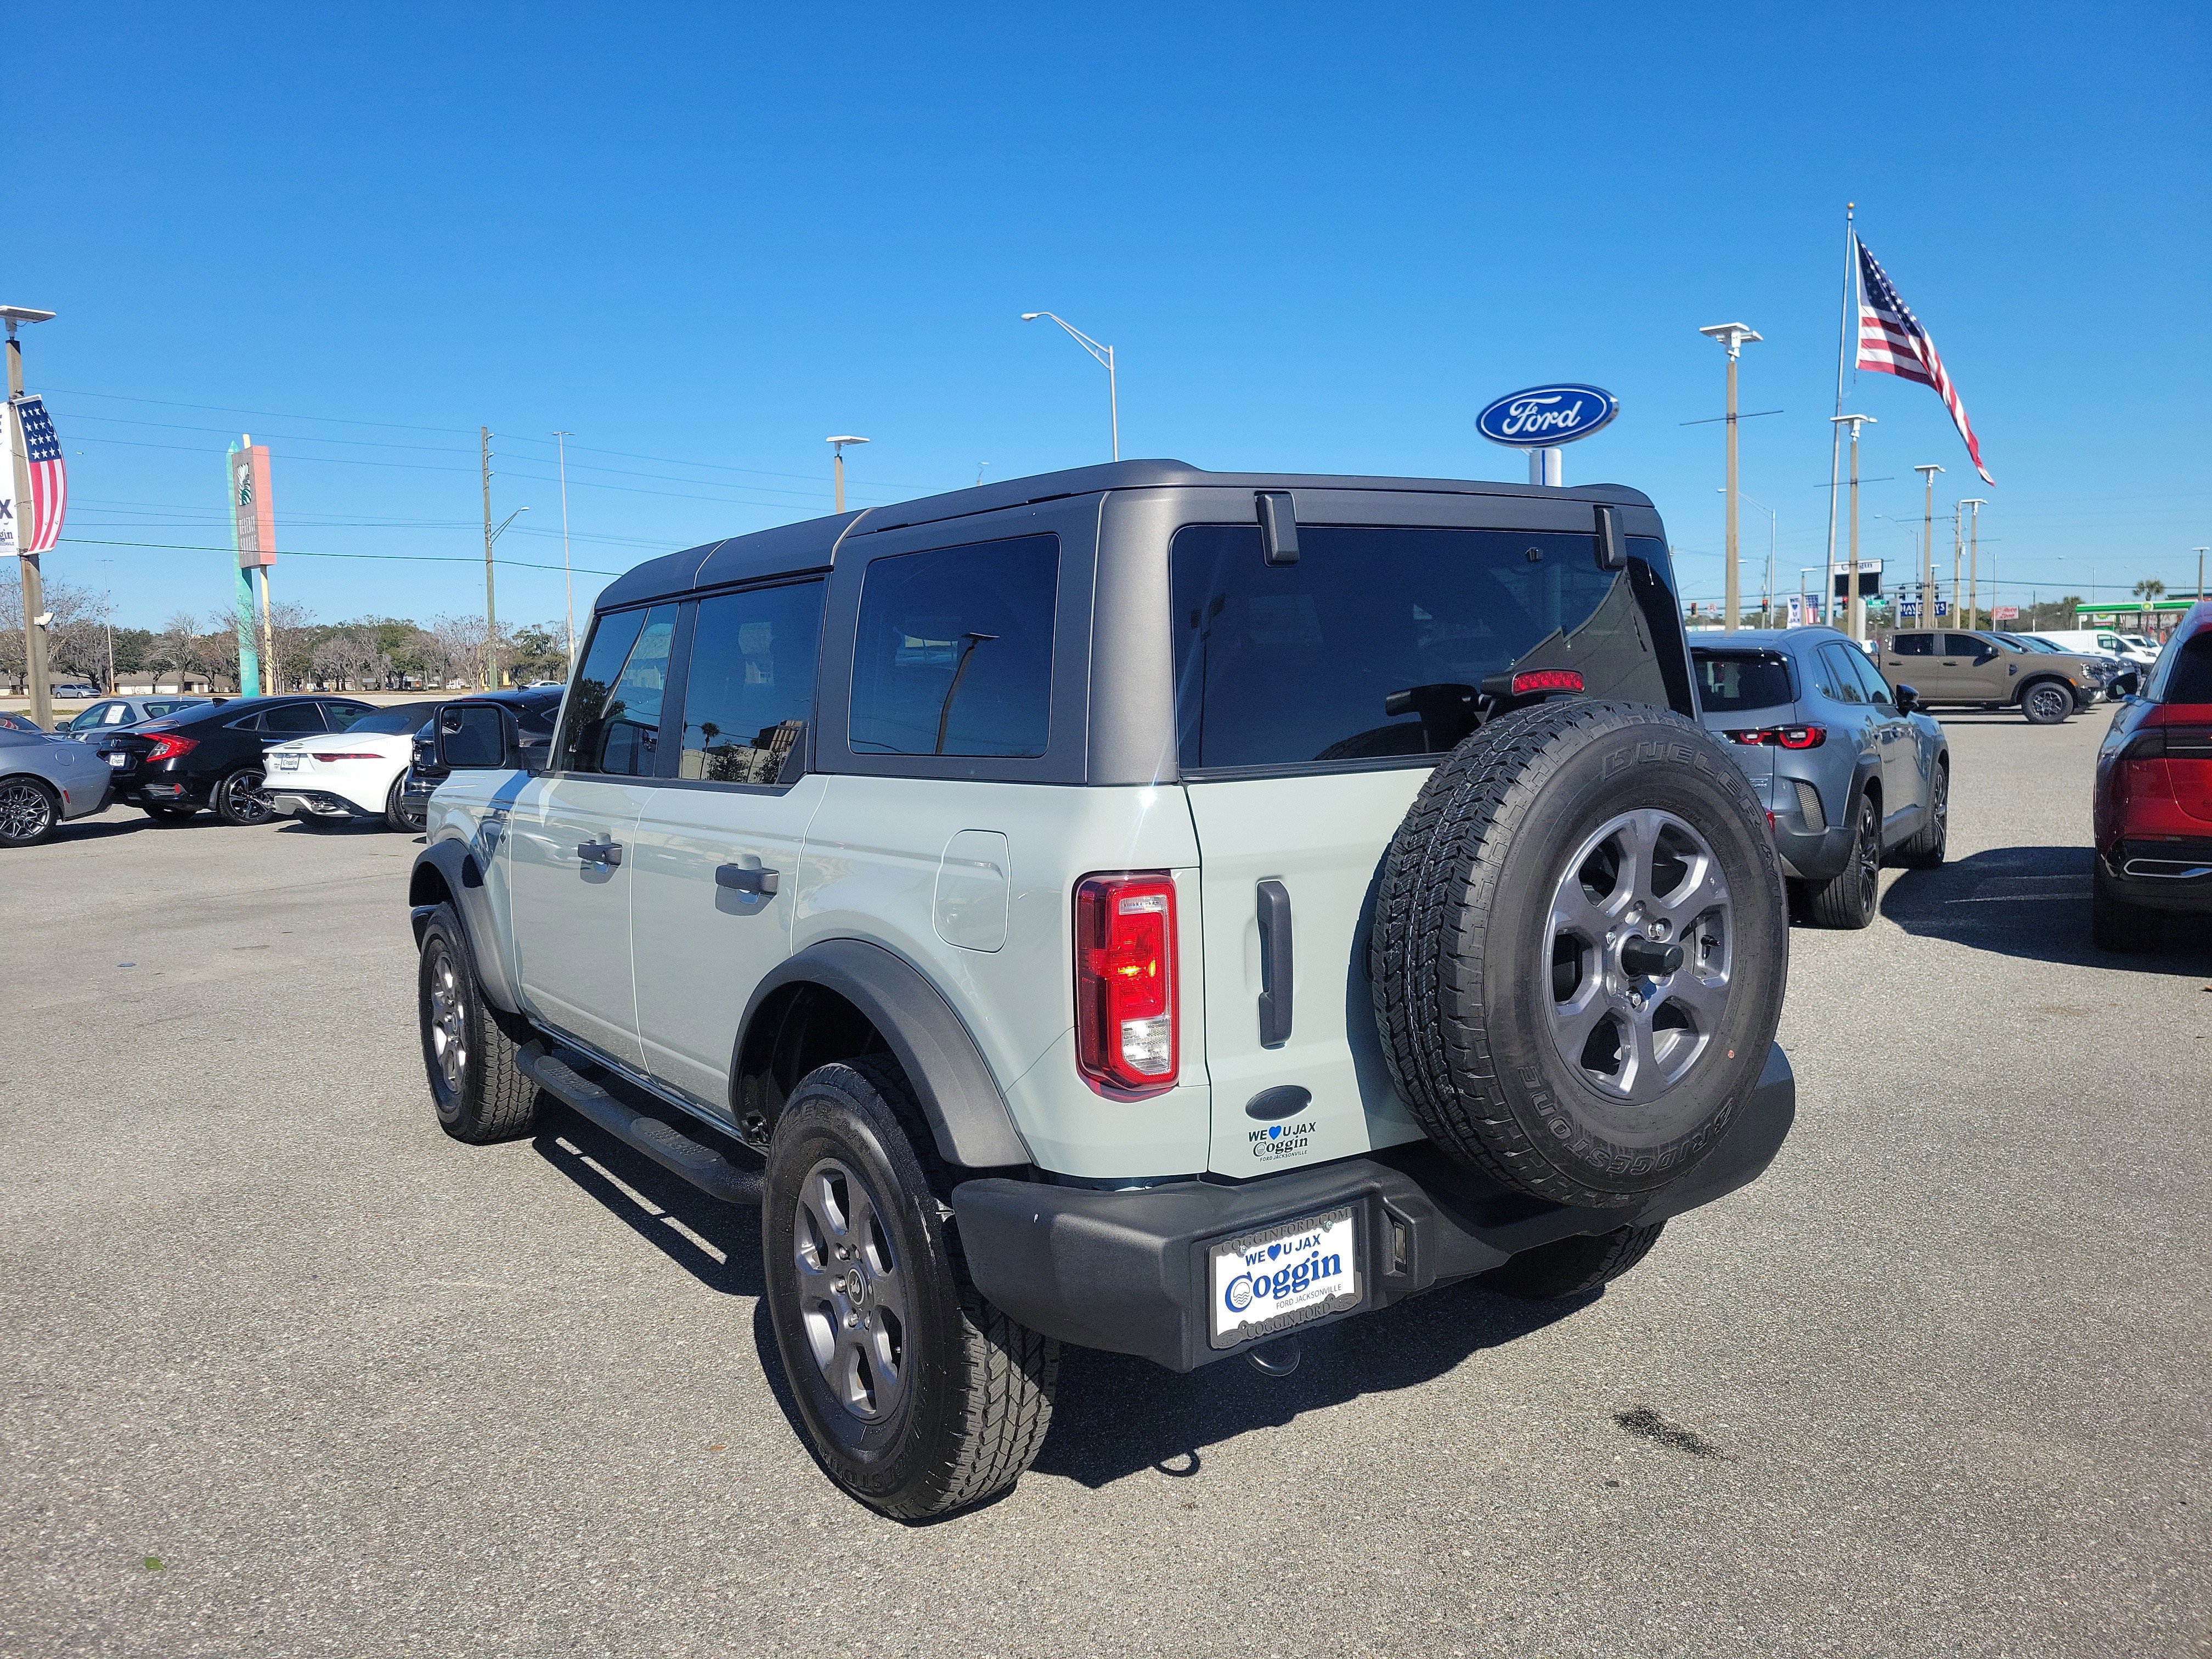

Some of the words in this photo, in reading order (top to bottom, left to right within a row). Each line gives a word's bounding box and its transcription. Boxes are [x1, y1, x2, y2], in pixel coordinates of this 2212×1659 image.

[1502, 395, 1583, 435] Ford
[239, 515, 256, 535] REGENCY
[240, 534, 257, 555] SQUARE
[1900, 602, 1945, 614] HAVEYS
[1602, 740, 1762, 828] DUELER
[1248, 1129, 1268, 1142] WE
[1283, 1125, 1291, 1137] U
[1293, 1121, 1317, 1135] JAX
[1517, 1065, 1733, 1176] BRIDGESTONE
[1253, 1135, 1308, 1157] Coggin
[1273, 1150, 1308, 1160] JACKSONVILLE
[1221, 1207, 1349, 1254] COGGINFORD.COM
[1245, 1250, 1266, 1267] WE
[1283, 1242, 1293, 1255] U
[1295, 1233, 1321, 1252] JAX
[1224, 1250, 1342, 1313] Coggin
[1276, 1298, 1294, 1310] FORD
[1295, 1284, 1342, 1303] JACKSONVILLE
[1246, 1312, 1295, 1338] COGGIN
[1299, 1302, 1331, 1321] FORD
